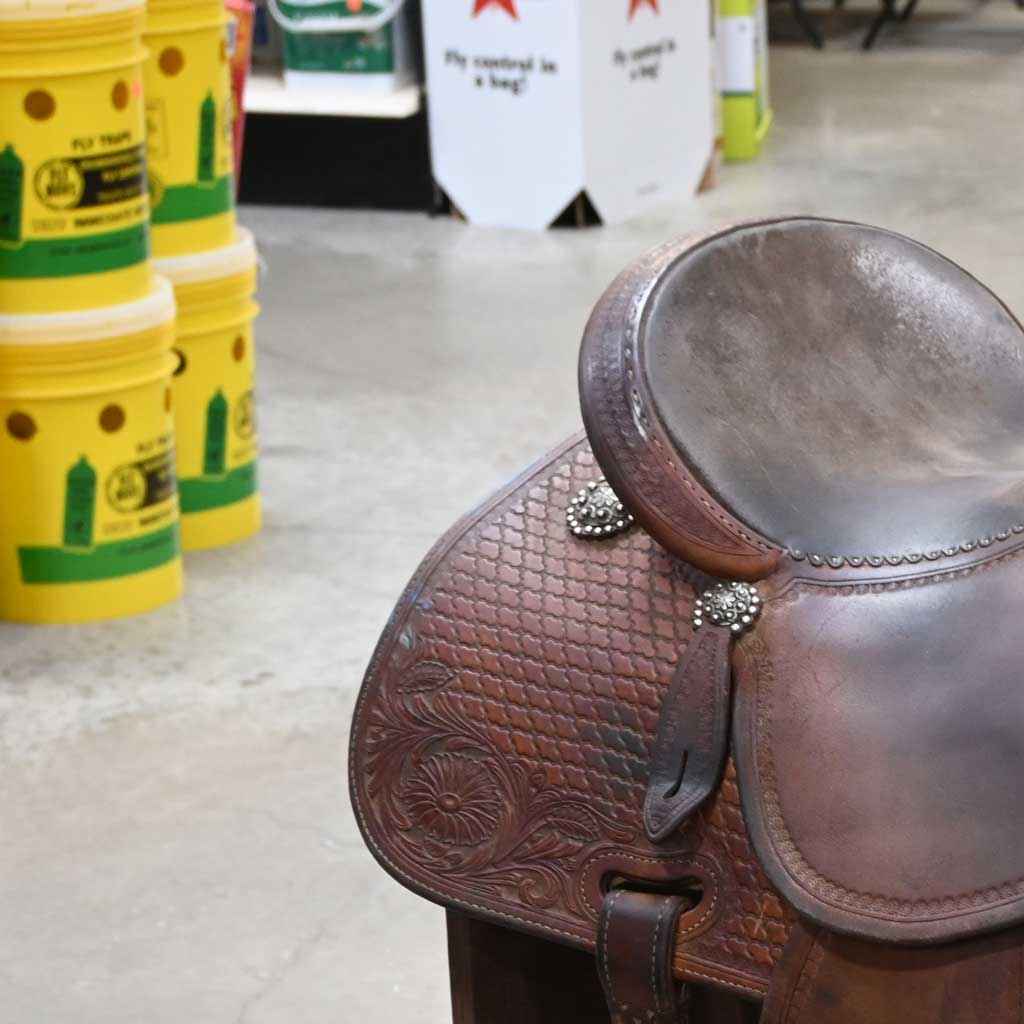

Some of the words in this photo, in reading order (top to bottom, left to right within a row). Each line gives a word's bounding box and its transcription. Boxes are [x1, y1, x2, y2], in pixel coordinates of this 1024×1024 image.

[444, 48, 467, 70] Fly
[474, 54, 534, 70] control
[540, 56, 558, 74] in
